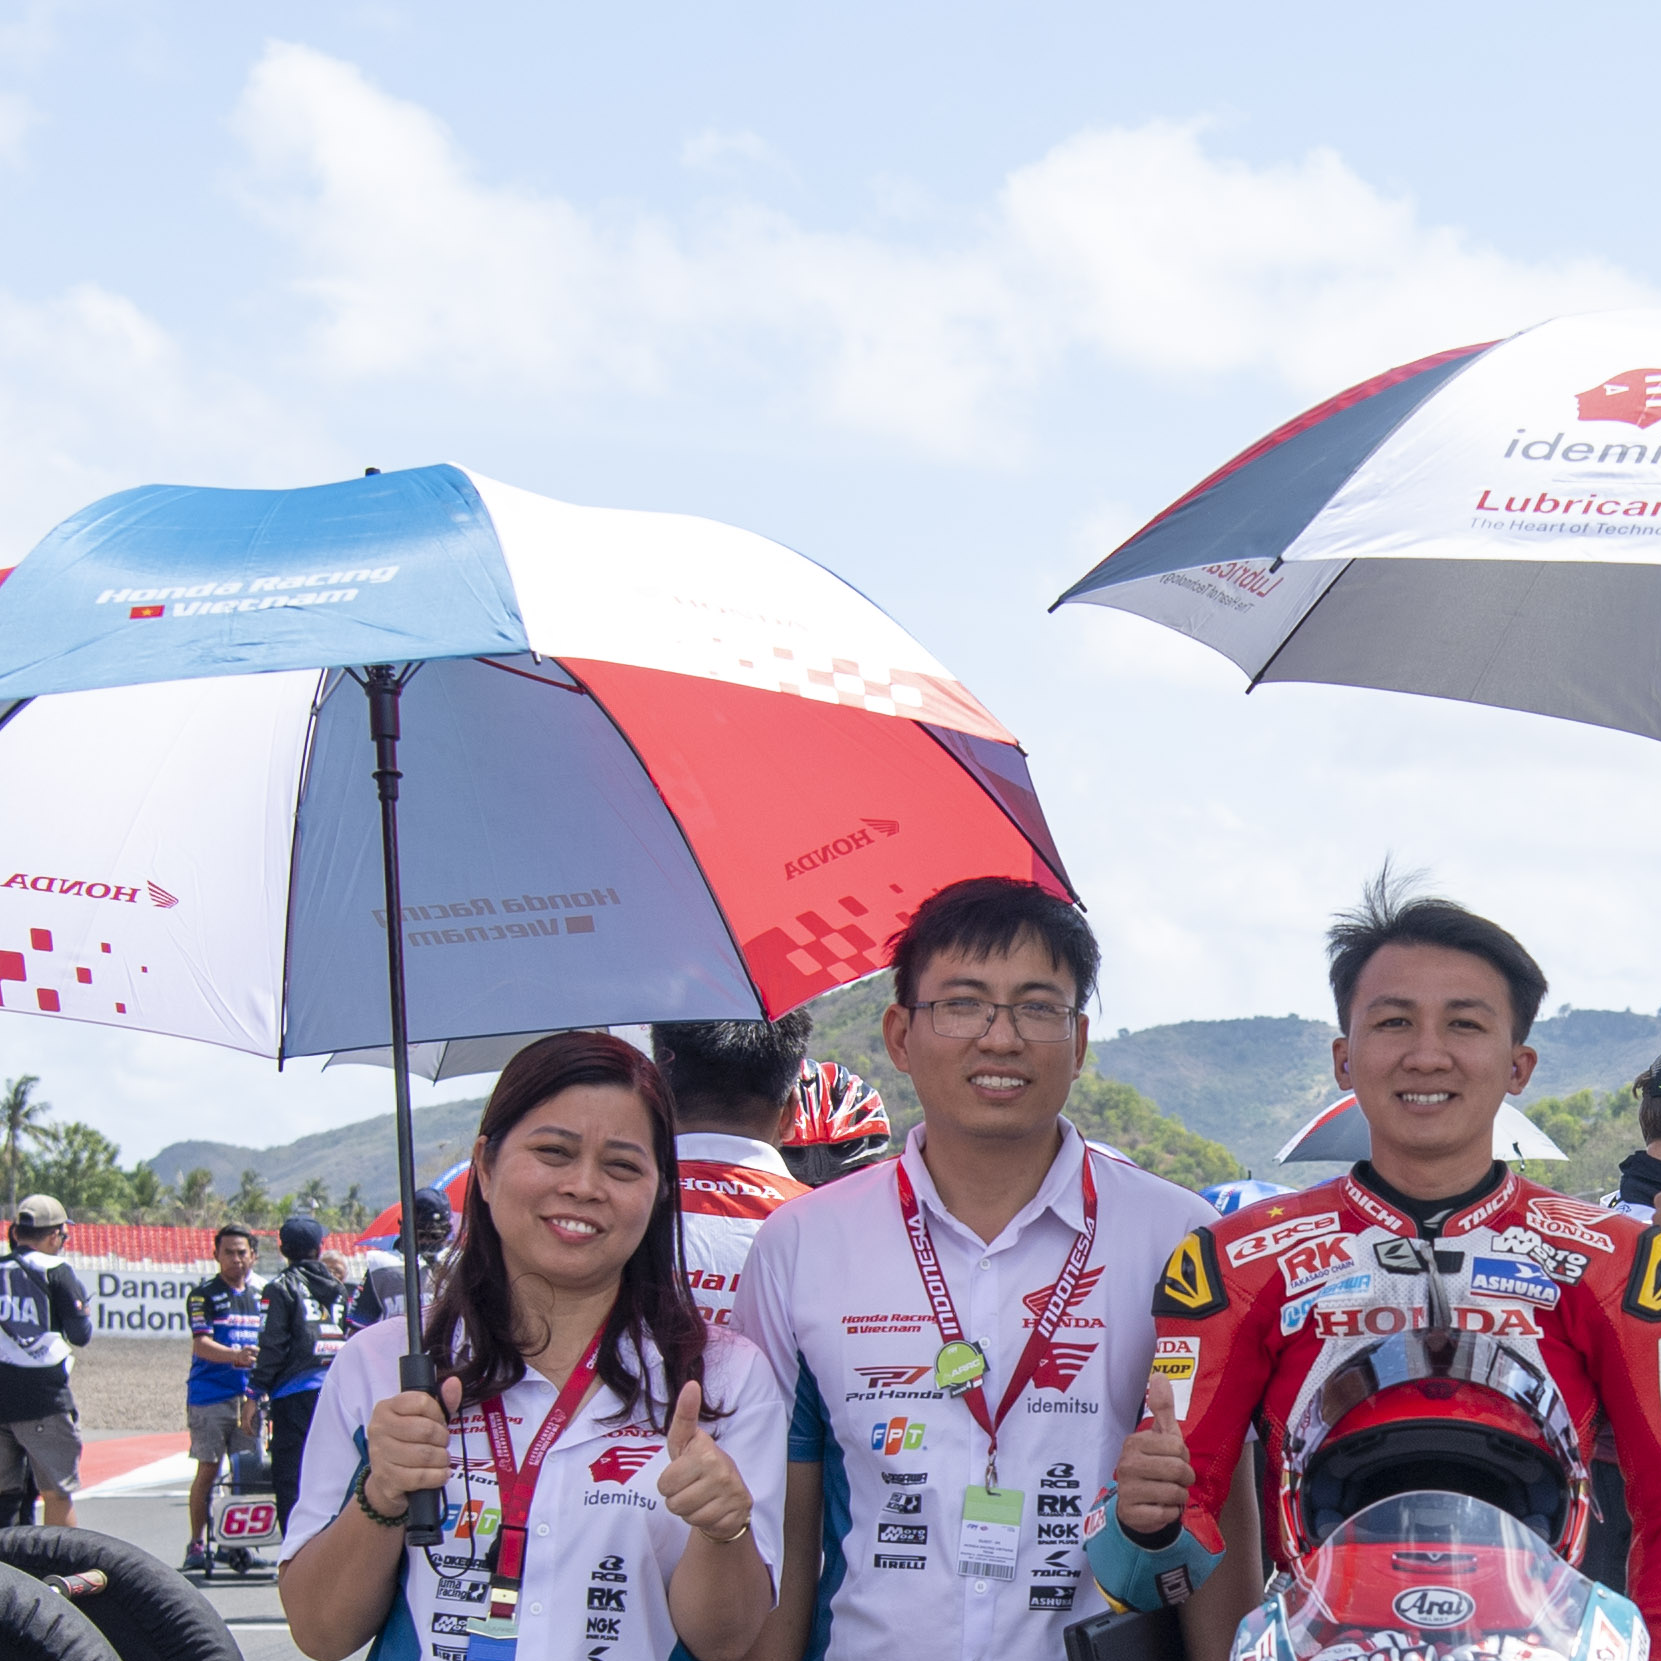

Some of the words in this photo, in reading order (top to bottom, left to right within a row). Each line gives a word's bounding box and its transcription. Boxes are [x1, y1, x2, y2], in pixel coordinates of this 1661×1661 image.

[1470, 517, 1504, 530] The
[1509, 519, 1565, 533] Heart
[1569, 522, 1590, 534] of
[96, 581, 243, 605] Honda
[249, 566, 399, 593] Racing
[171, 588, 359, 617] Vietnam
[679, 1177, 786, 1201] HONDA
[1345, 1183, 1403, 1231] TAICHI
[1458, 1183, 1515, 1231] TAICHI
[1273, 1216, 1336, 1245] RCB
[1530, 1218, 1611, 1249] HONDA
[1284, 1236, 1353, 1281] RK
[908, 1214, 959, 1335] INDONESIA
[1038, 1217, 1096, 1338] INDONESIA
[1290, 1270, 1330, 1289] TAKASAGO
[1331, 1260, 1355, 1273] CHAIN
[98, 1274, 206, 1298] Danan
[1472, 1274, 1556, 1301] ASHUKA
[842, 1315, 888, 1324] Honda
[859, 1325, 922, 1333] Vietnam
[1022, 1317, 1107, 1329] HNDA
[846, 1392, 875, 1402] Pro
[878, 1389, 944, 1400] Honda
[1026, 1398, 1100, 1414] idemitsu
[872, 1424, 925, 1448] FPT
[1041, 1479, 1080, 1489] RCB
[584, 1488, 657, 1510] idemitsu
[1037, 1494, 1082, 1515] RK
[223, 1504, 276, 1535] 69
[1037, 1524, 1079, 1539] NGK
[874, 1553, 927, 1570] PIRELLI
[440, 1579, 462, 1588] uma
[591, 1571, 628, 1583] RCB
[1031, 1569, 1081, 1578] TAICHI
[438, 1588, 468, 1599] racing
[586, 1587, 628, 1608] RK
[1400, 1592, 1466, 1616] Arai
[586, 1617, 621, 1635] NGK
